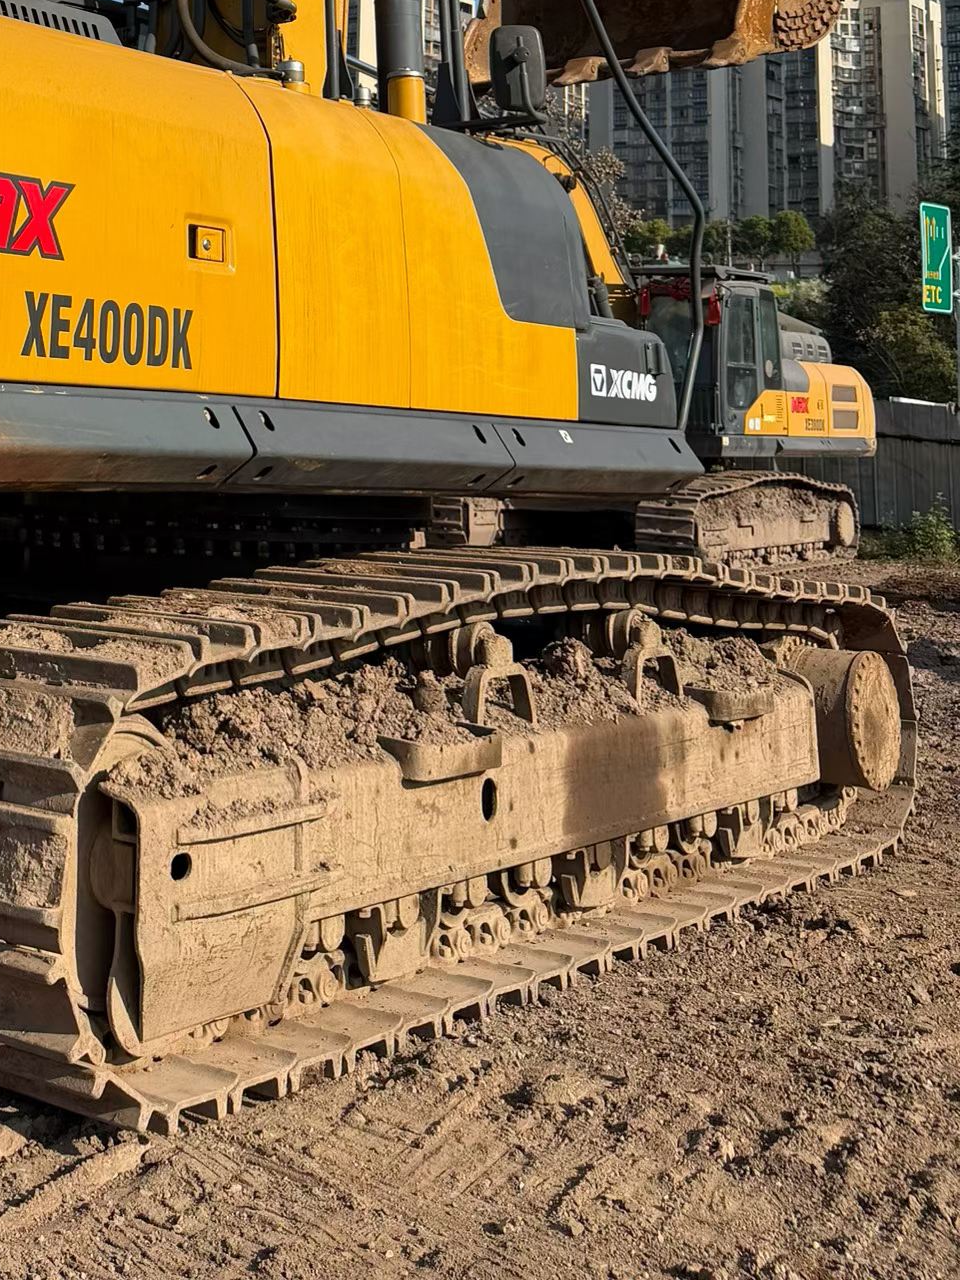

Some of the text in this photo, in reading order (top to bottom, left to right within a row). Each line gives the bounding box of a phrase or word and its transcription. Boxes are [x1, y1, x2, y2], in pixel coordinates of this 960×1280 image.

[923, 285, 942, 304] ETC
[21, 291, 194, 370] XE400DK
[607, 368, 658, 402] XCMG
